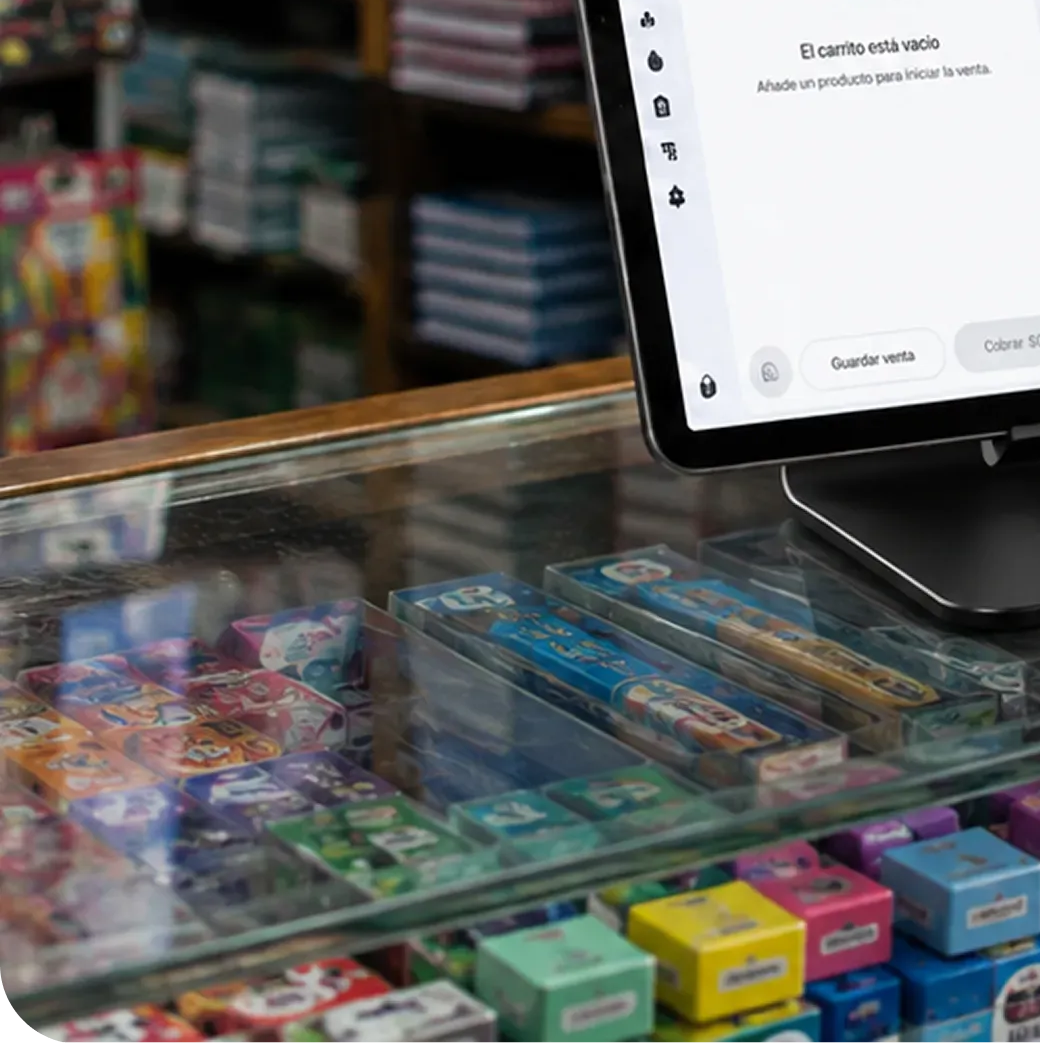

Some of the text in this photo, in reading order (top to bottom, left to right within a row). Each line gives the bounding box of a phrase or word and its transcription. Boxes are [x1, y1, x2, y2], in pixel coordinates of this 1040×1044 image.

[800, 43, 815, 60] El
[817, 41, 866, 58] carrito
[799, 77, 816, 90] un
[818, 73, 874, 91] producto
[875, 71, 904, 86] para
[942, 65, 955, 78] la
[830, 348, 917, 370] Guardar venta
